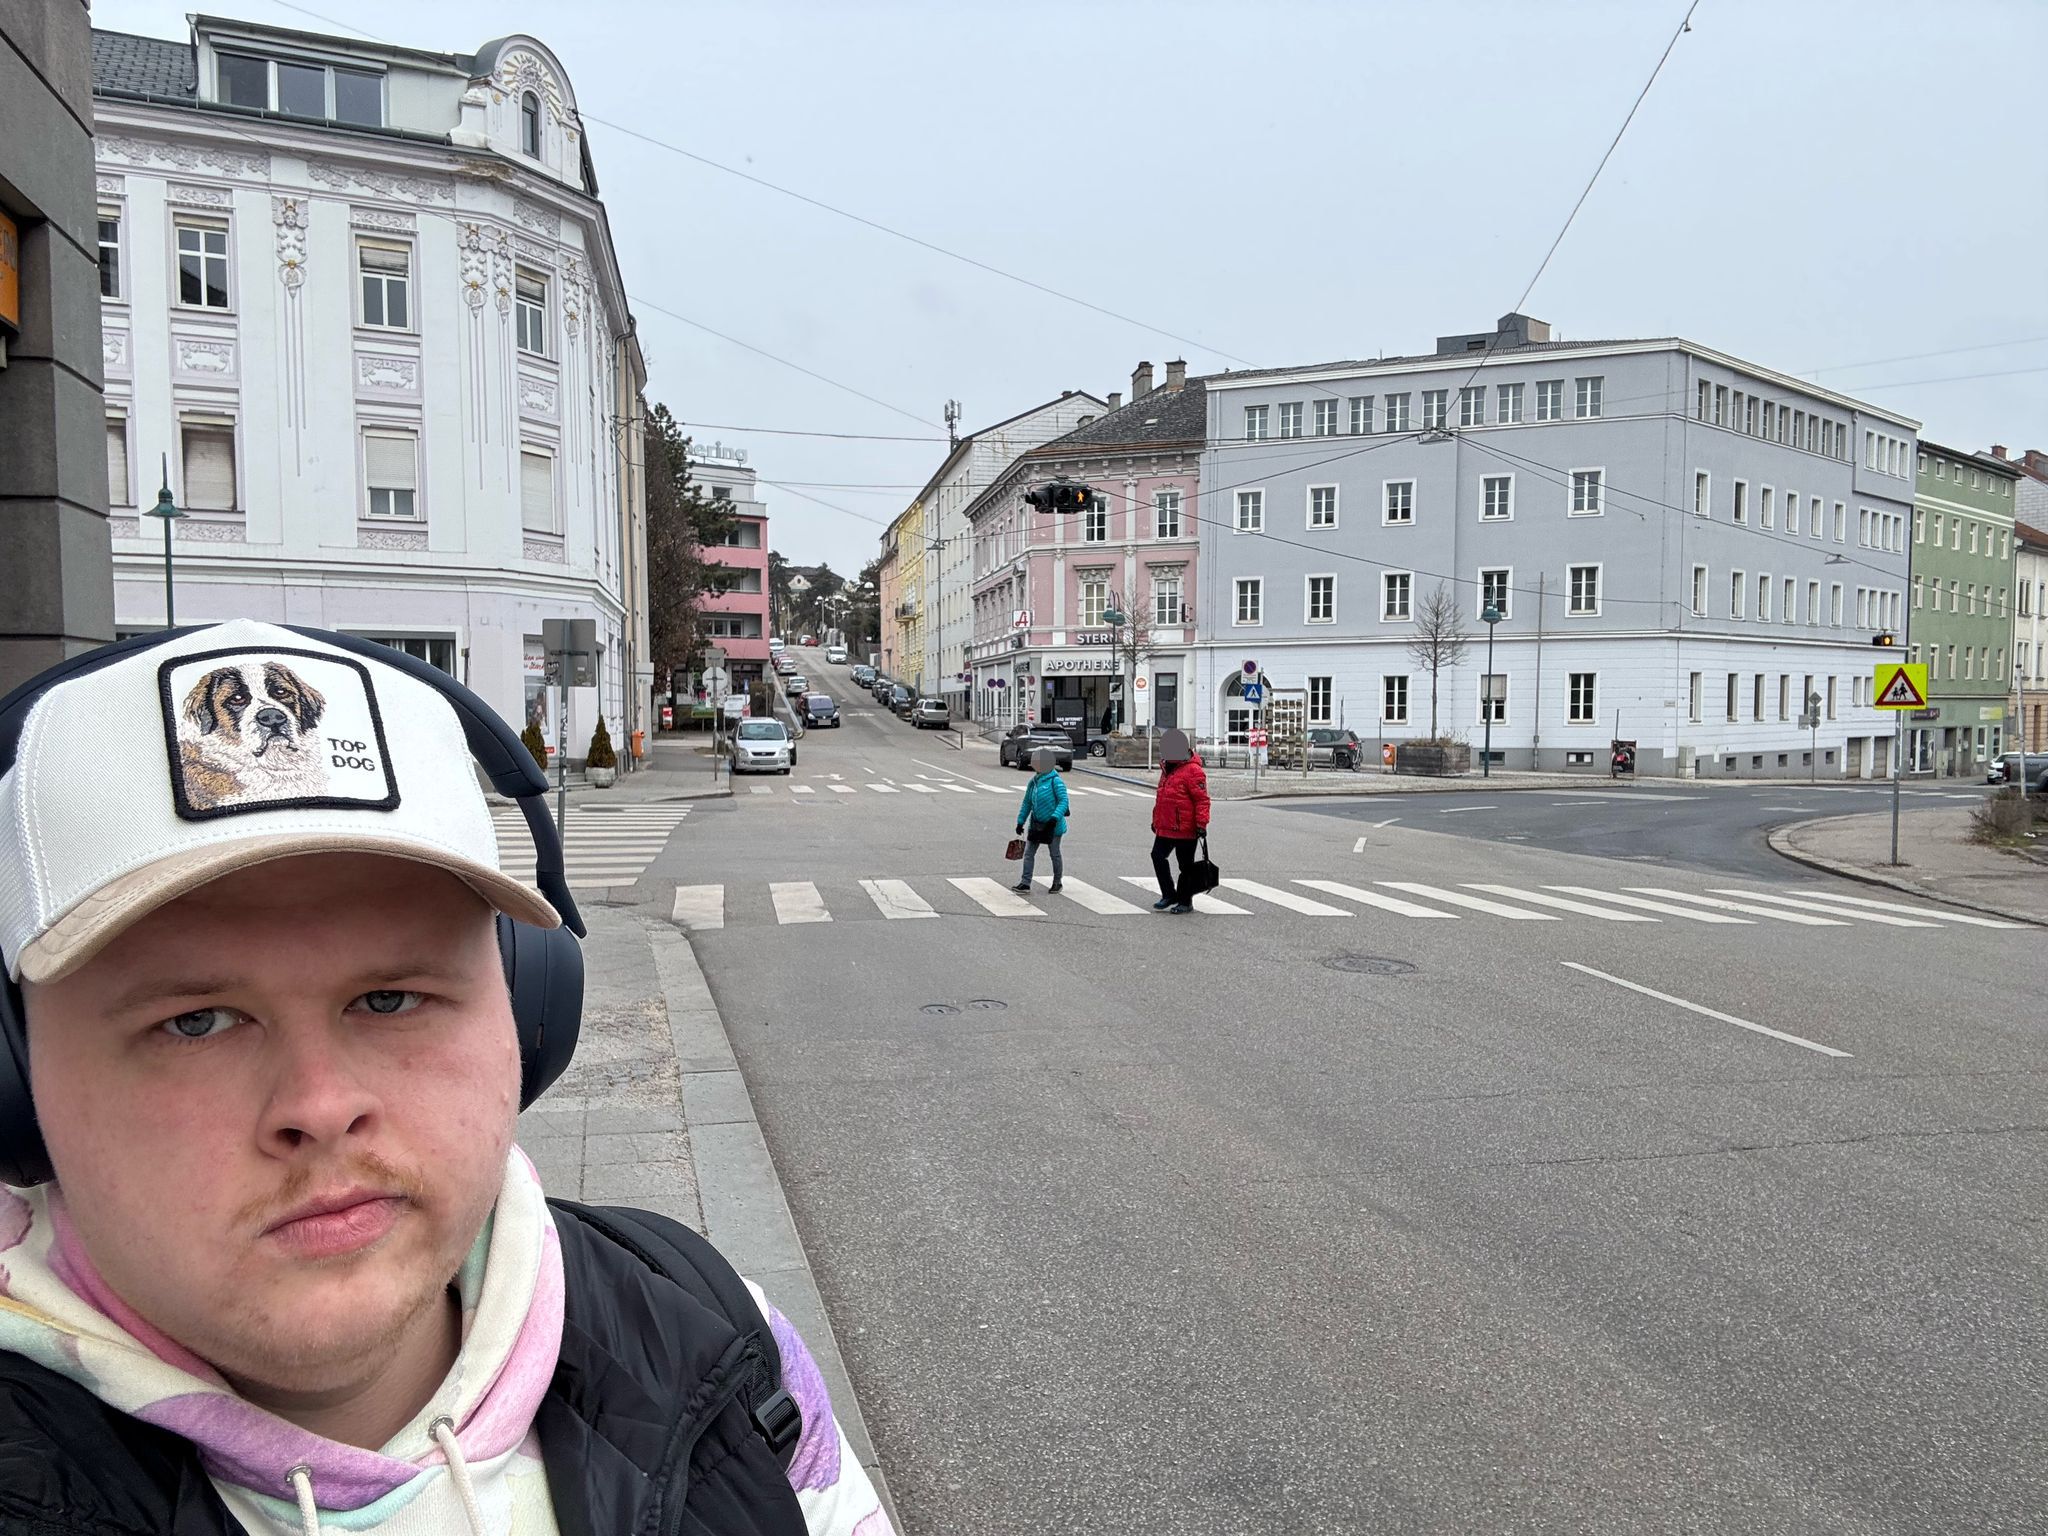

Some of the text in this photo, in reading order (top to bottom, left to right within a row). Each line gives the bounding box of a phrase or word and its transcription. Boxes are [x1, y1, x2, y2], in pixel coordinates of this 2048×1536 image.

[1077, 633, 1118, 644] STERN
[1046, 660, 1120, 671] APOTHEKE
[327, 738, 367, 753] TOP
[331, 754, 376, 771] DOG
